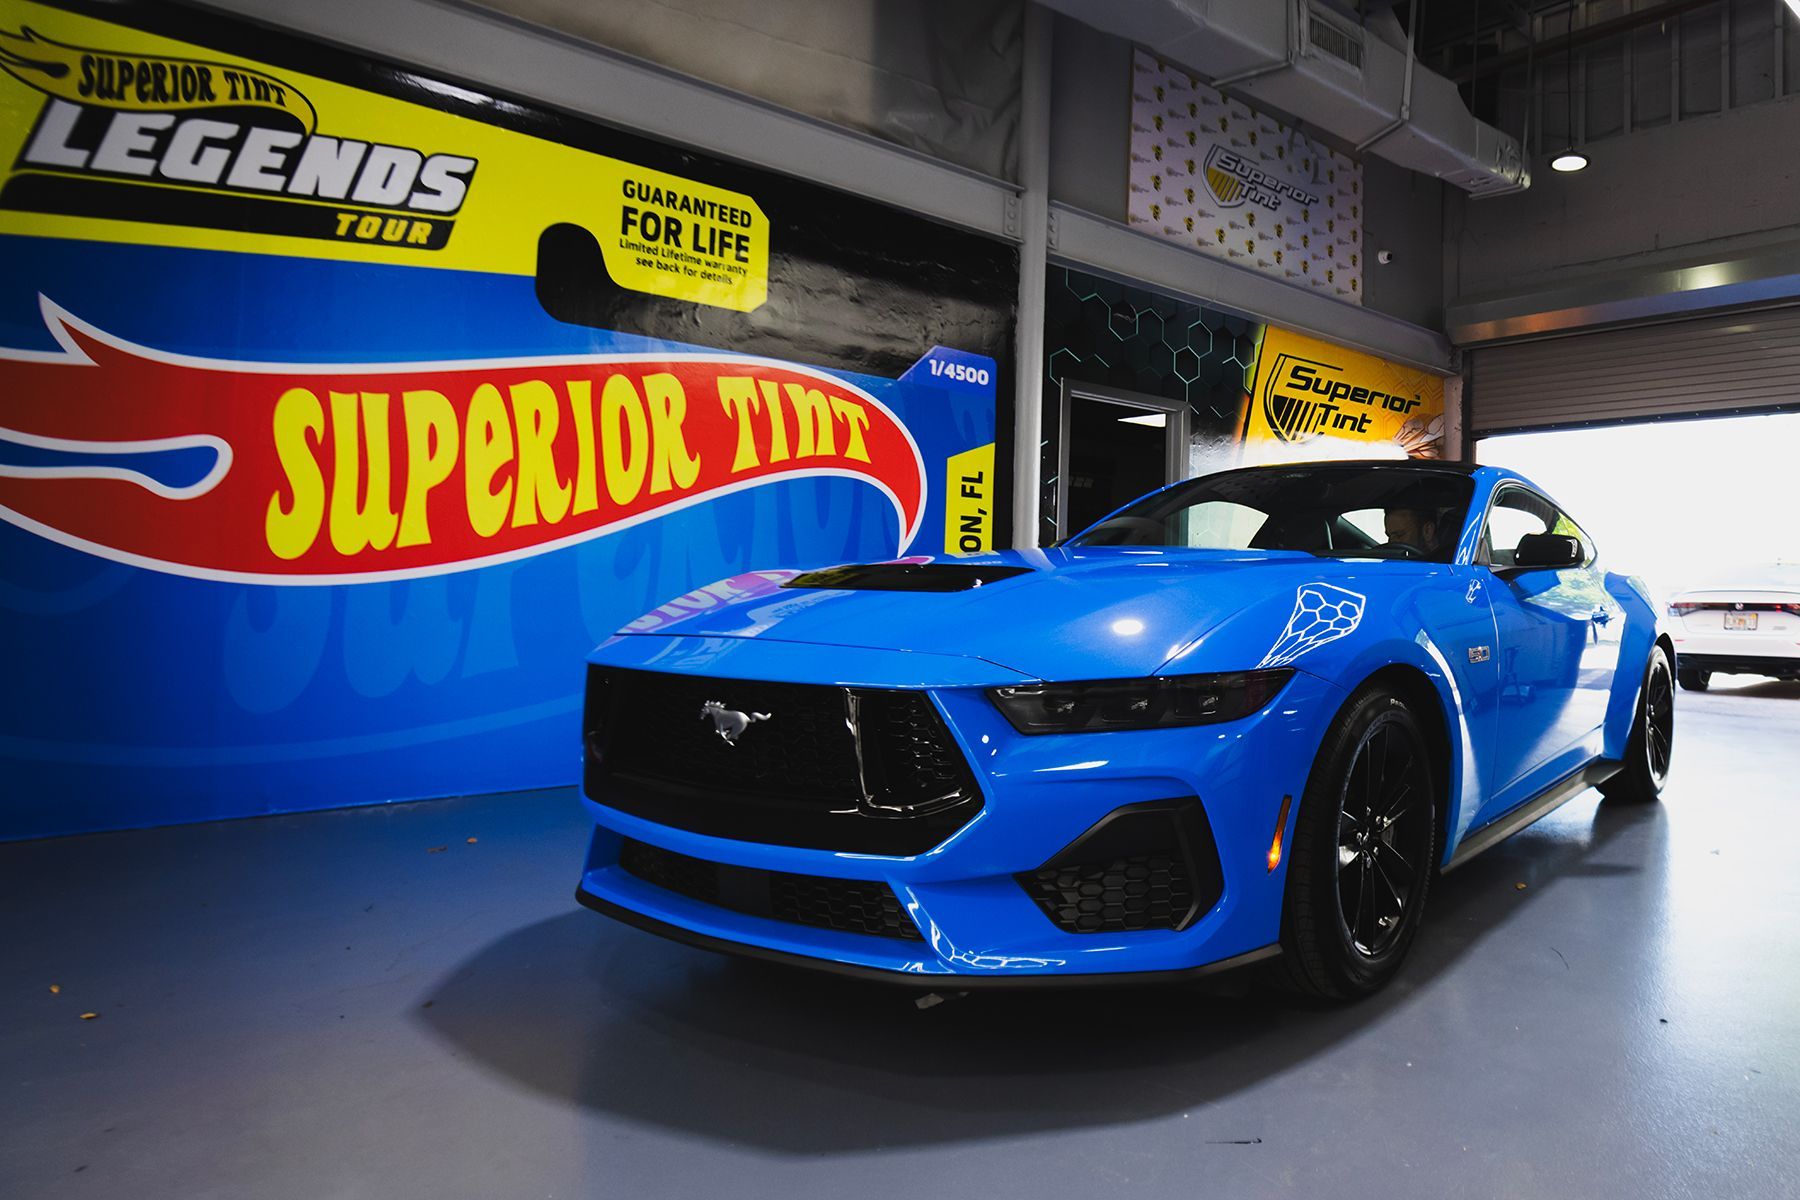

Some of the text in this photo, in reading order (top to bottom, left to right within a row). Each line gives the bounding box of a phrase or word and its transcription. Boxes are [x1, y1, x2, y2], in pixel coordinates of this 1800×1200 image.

[24, 98, 476, 212] LEGENDS
[1217, 151, 1319, 206] Superior
[1240, 180, 1281, 211] Tint
[622, 179, 752, 228] GUARANTEED
[336, 213, 433, 245] TOUR
[621, 205, 750, 263] FOR LIFE
[619, 238, 748, 277] Limited Lifetime warranty
[635, 257, 733, 285] see back for details
[929, 359, 989, 386] 1/4500
[1286, 366, 1421, 414] Superior
[1318, 402, 1373, 433] Tint
[960, 471, 984, 499] FL
